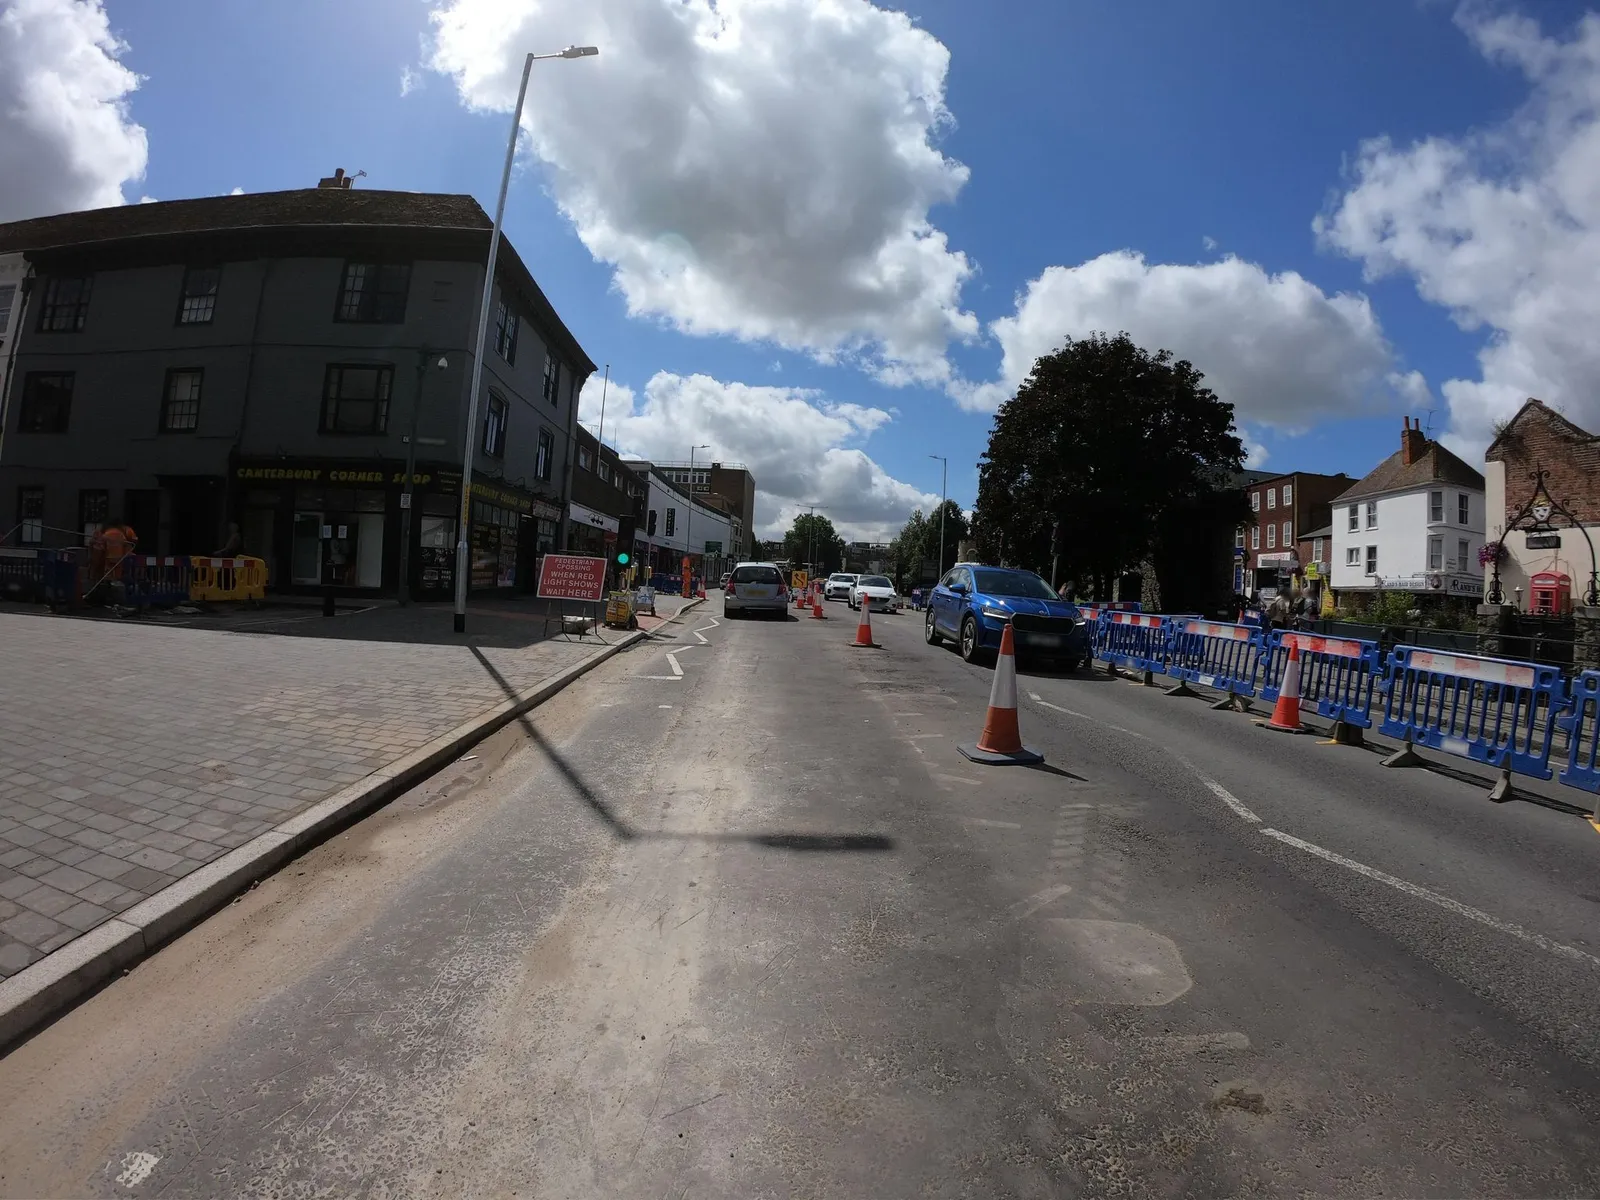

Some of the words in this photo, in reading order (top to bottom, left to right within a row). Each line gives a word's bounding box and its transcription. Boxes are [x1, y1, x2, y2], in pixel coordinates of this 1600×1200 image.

[236, 468, 321, 481] CANTERBURY
[329, 470, 384, 482] CORNER
[554, 557, 595, 566] PEDESTRIAN
[556, 563, 591, 572] CROSSING
[550, 570, 576, 579] WHEN
[577, 572, 595, 580] RED
[543, 578, 567, 586] LIGHT
[568, 579, 599, 589] SHOWS
[545, 588, 566, 596] WAIT
[567, 588, 594, 598] HERE
